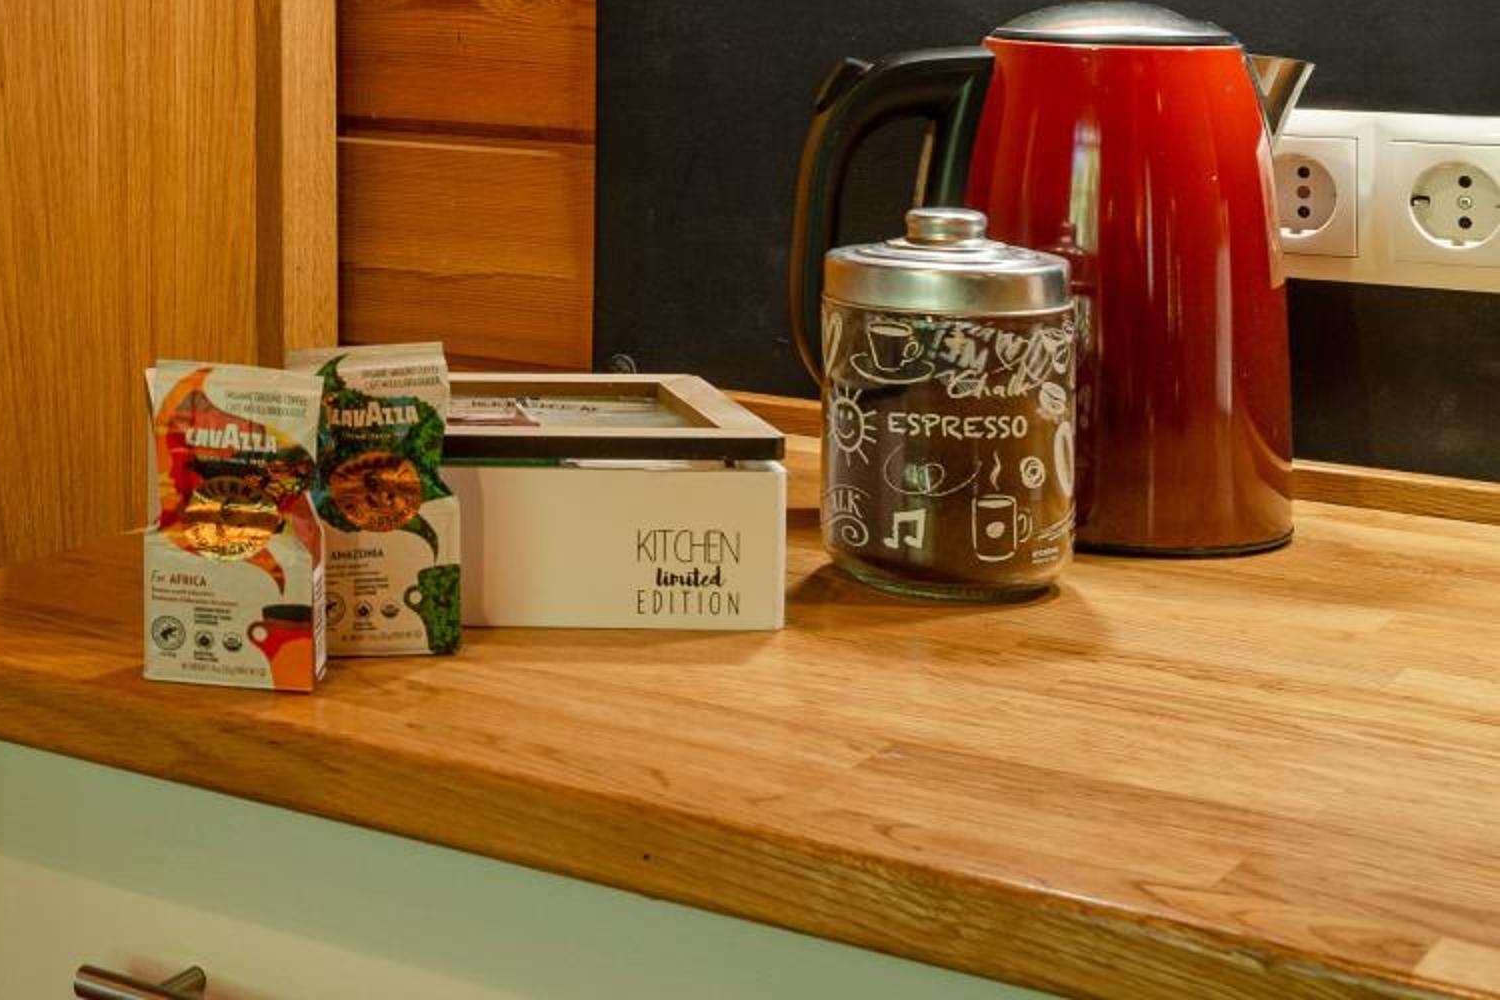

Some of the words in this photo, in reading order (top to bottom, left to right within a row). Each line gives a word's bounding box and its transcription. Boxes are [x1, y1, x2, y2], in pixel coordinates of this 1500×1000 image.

[329, 400, 420, 427] LAVAZZA
[887, 413, 1028, 441] ESPRESSO
[185, 423, 277, 453] LAVAZZA
[636, 529, 741, 564] KITCHEN
[170, 573, 207, 588] AFRICA
[655, 566, 723, 588] limited
[636, 590, 740, 616] EDITION
